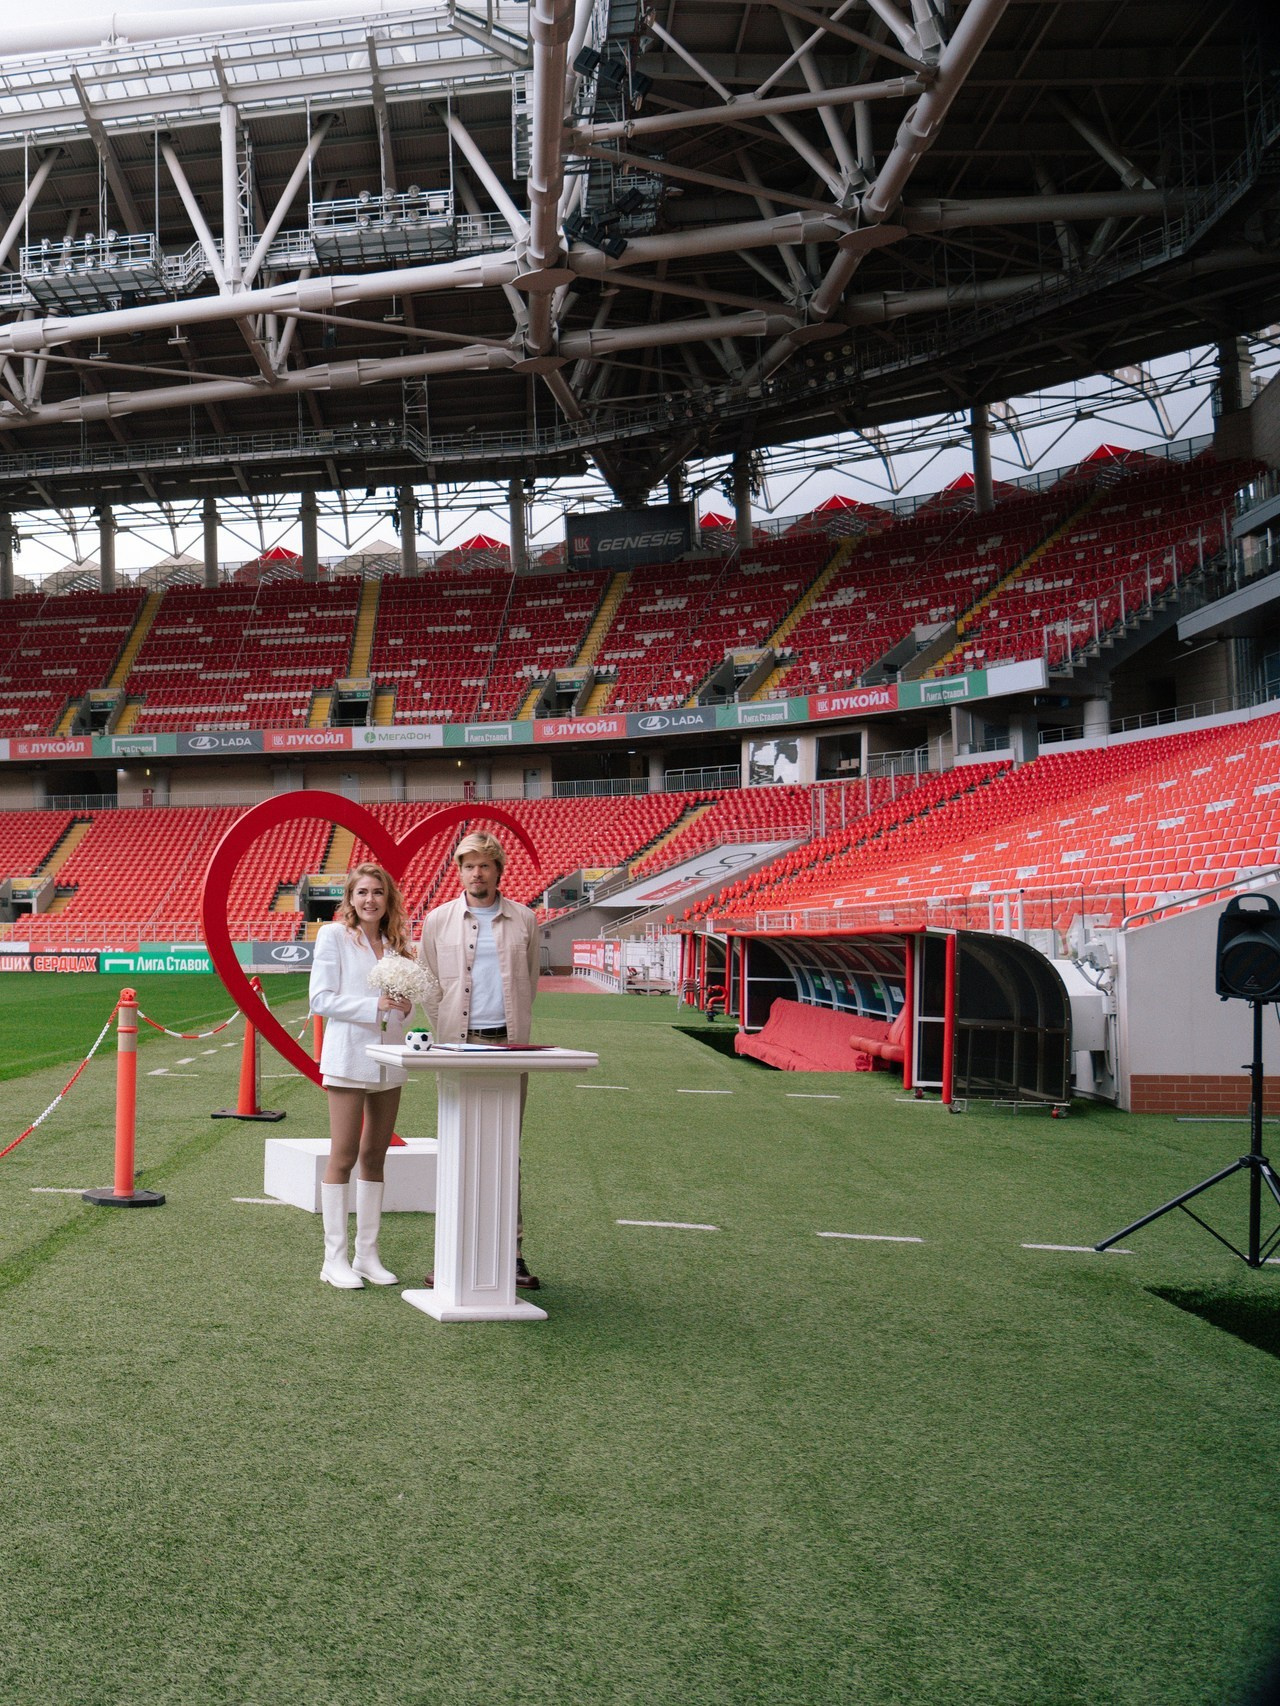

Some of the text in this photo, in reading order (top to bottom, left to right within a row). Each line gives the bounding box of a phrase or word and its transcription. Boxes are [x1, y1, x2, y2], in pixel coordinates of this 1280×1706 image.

[597, 530, 684, 552] GENESIS
[831, 691, 889, 710] ЛУКОЙЛ
[672, 715, 704, 725] LADA
[557, 720, 617, 735] ЛУКОЙЛ
[221, 738, 252, 746] LADA
[286, 731, 344, 745] ЛУКОЙЛ
[30, 740, 84, 754] ЛУКОЙЛ
[33, 955, 97, 973] СЕРДЦАХ
